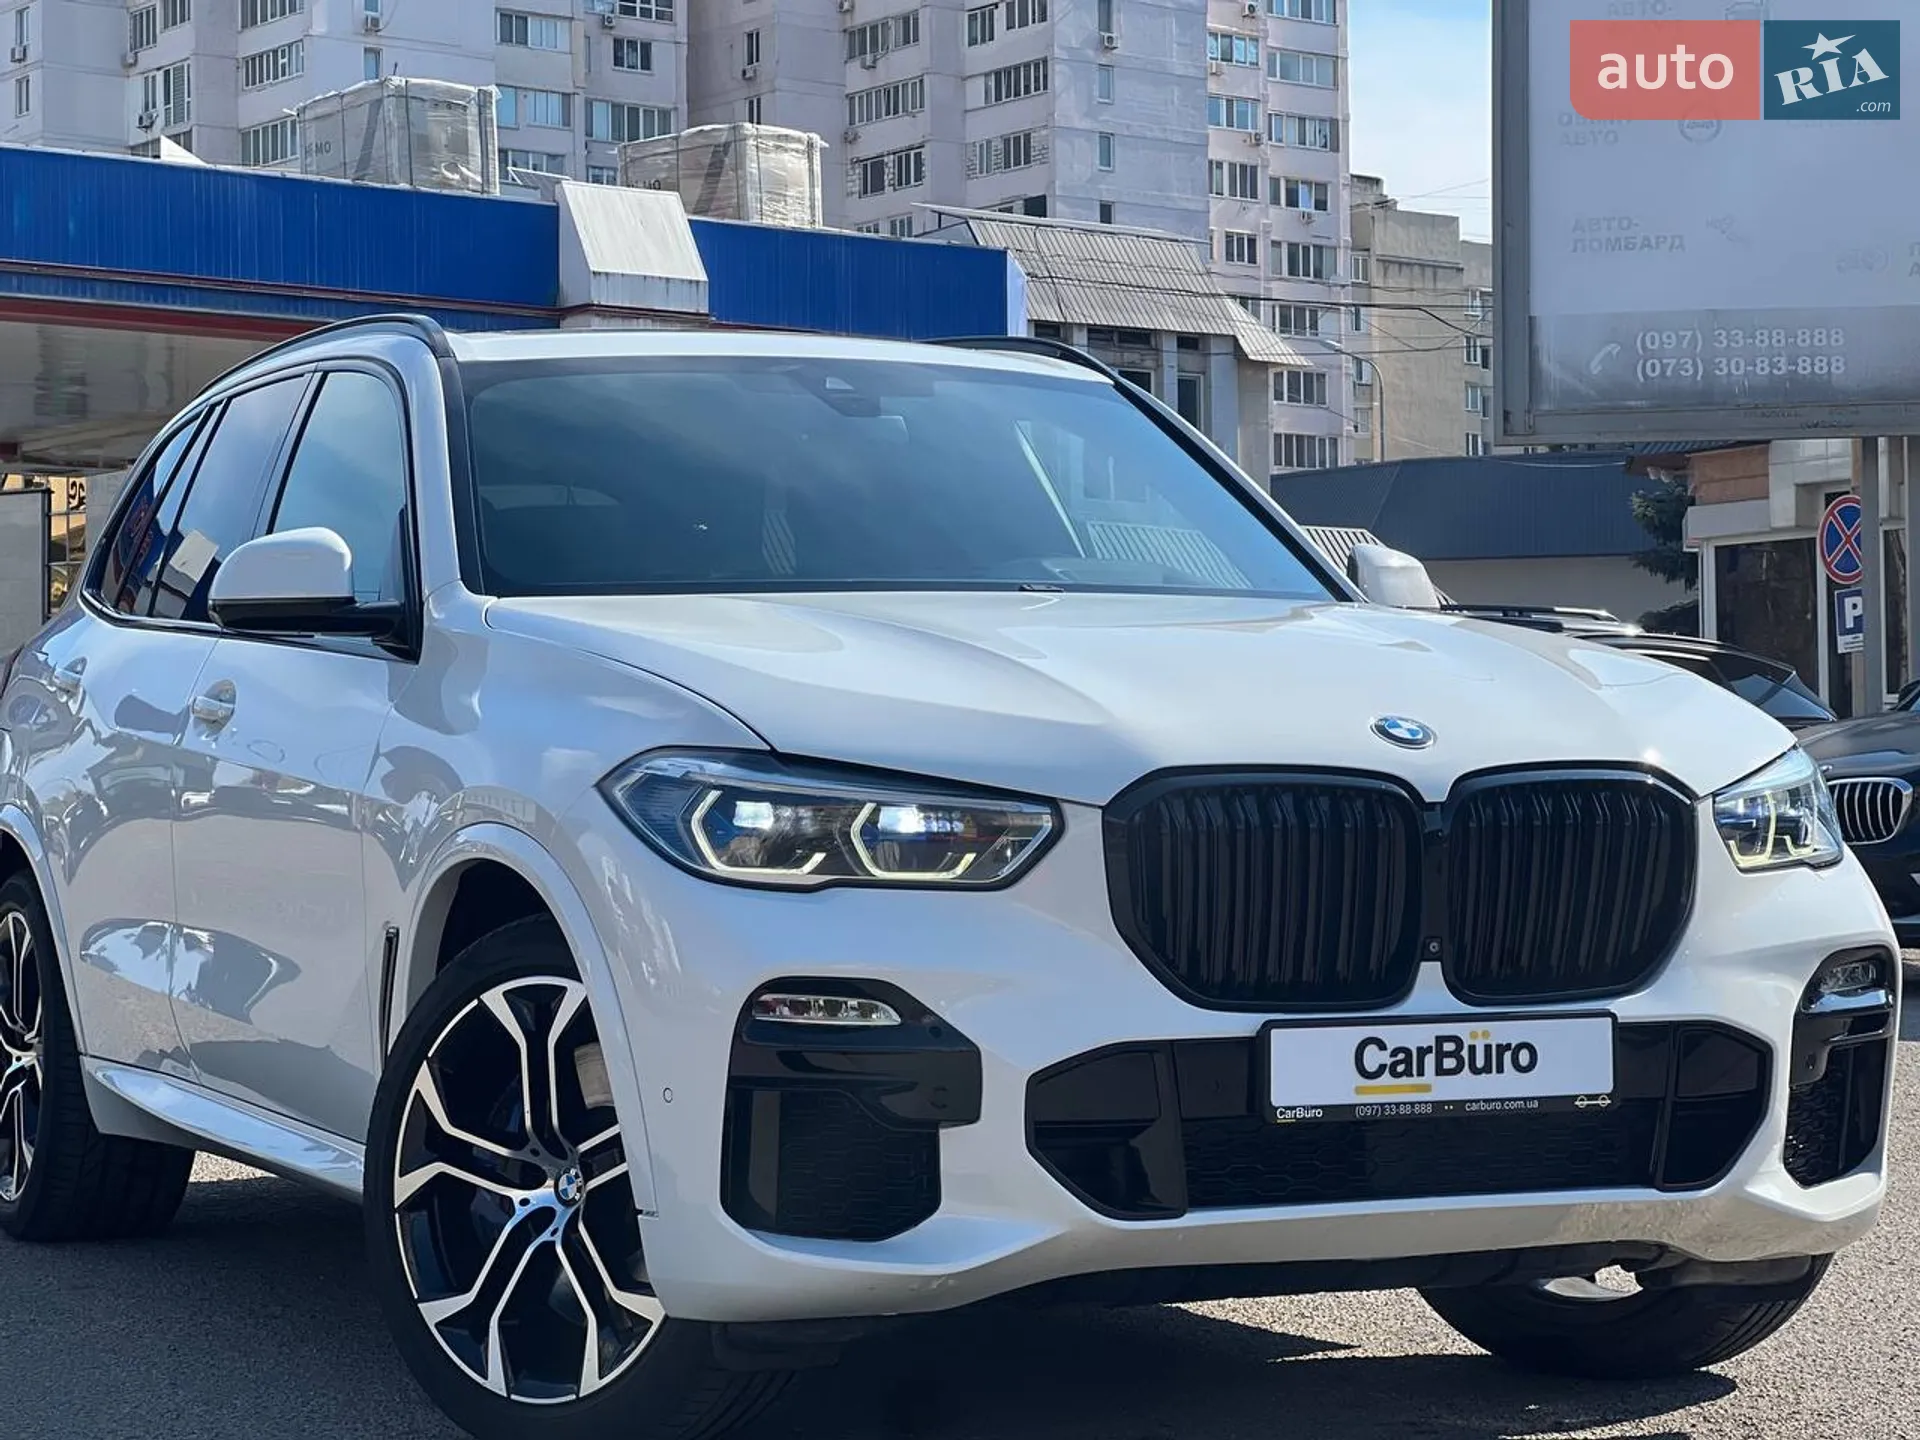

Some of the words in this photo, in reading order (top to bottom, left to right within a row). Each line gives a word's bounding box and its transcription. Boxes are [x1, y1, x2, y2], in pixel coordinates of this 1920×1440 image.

[1572, 216, 1640, 233] АВТО-
[1571, 234, 1686, 254] ЛОМБАРД
[1636, 330, 1703, 354] (097)
[1713, 328, 1845, 349] 33-88-888
[1636, 358, 1704, 382] (073)
[1714, 355, 1846, 376] 30-83-888
[1354, 1029, 1539, 1081] CarBüro
[1355, 1104, 1381, 1118] (097)
[1383, 1102, 1433, 1116] 33-88-888
[1465, 1098, 1539, 1112] carburo.com.ua
